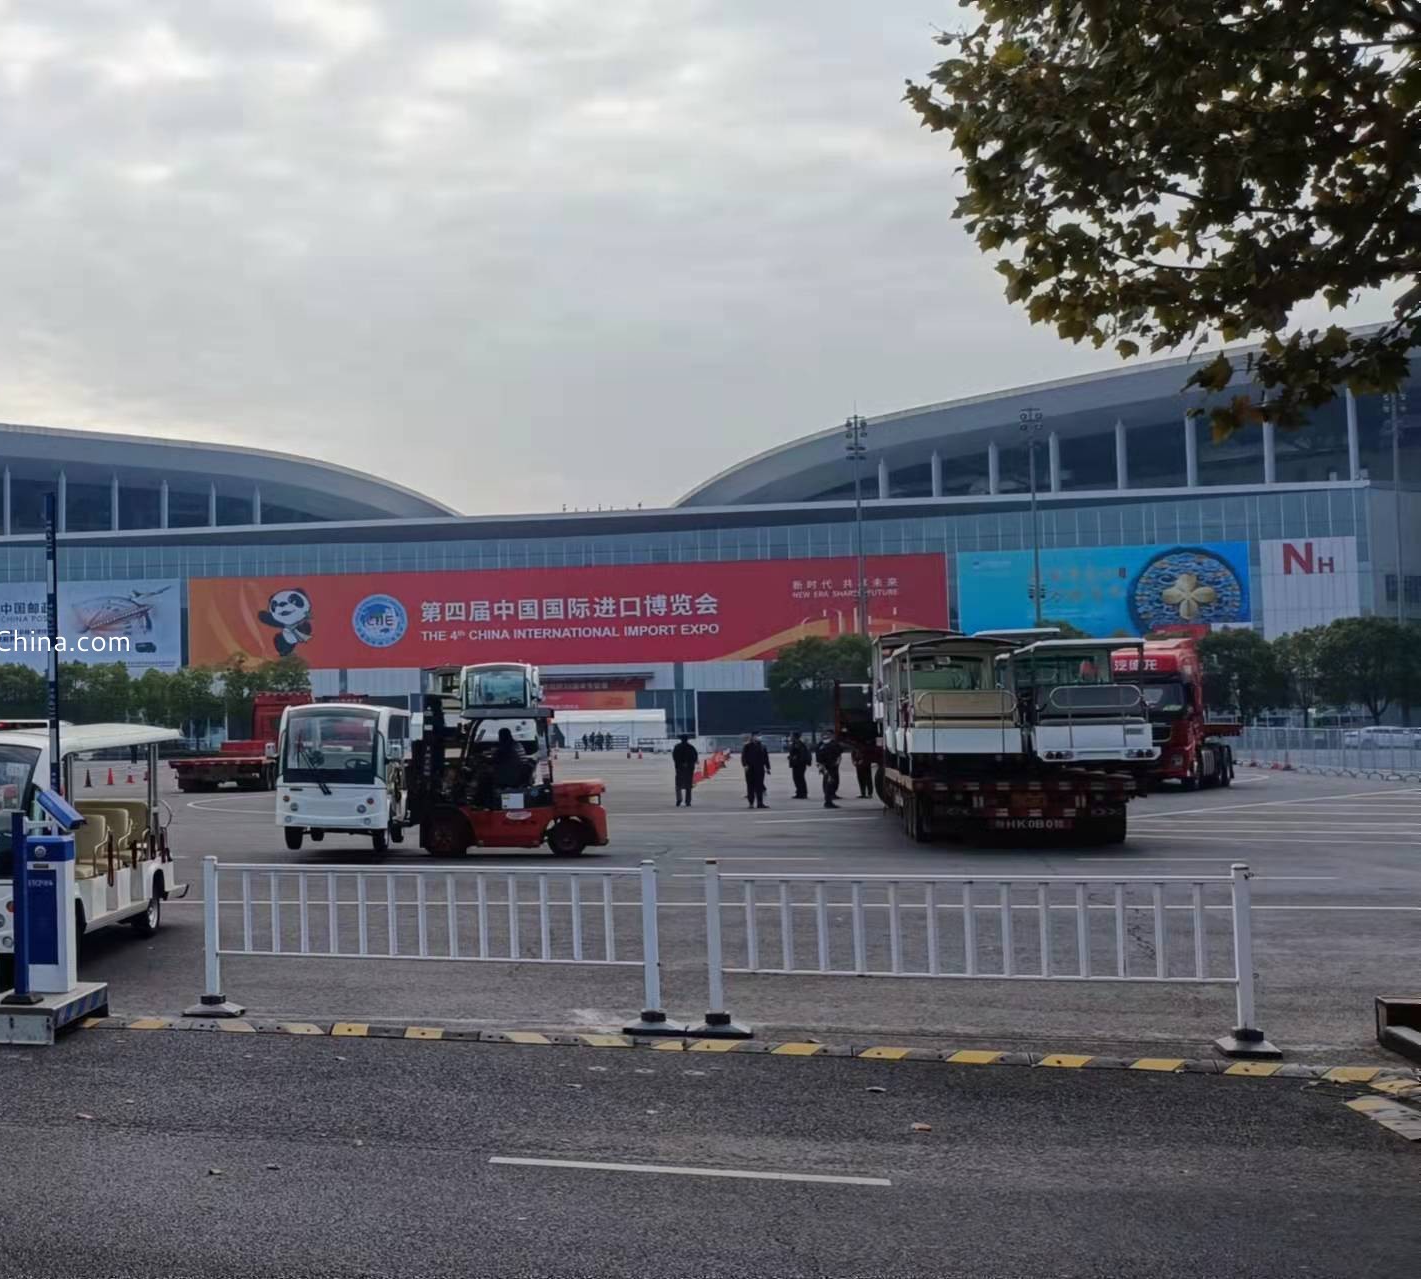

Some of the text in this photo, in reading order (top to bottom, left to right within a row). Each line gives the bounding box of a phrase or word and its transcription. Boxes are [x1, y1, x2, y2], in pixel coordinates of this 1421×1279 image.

[792, 591, 810, 599] NEW
[813, 590, 829, 598] ERA
[832, 589, 861, 597] SHARE
[421, 593, 718, 623] 第四届中国国际进口博览会
[1, 615, 48, 624] CHINA POS
[421, 623, 719, 641] THE 4th CHINA INTERNATIONAL IMPORT EXPO
